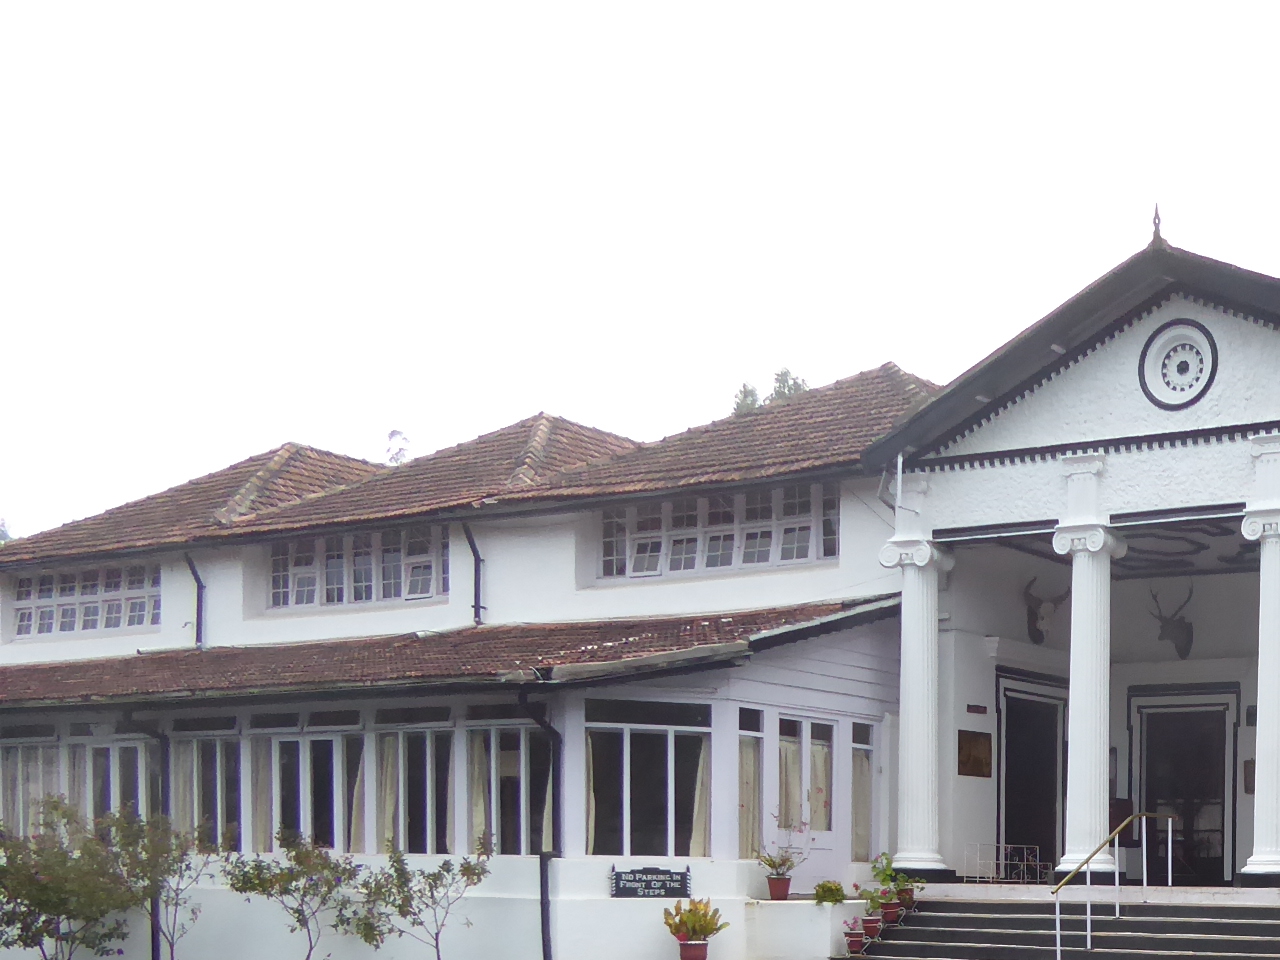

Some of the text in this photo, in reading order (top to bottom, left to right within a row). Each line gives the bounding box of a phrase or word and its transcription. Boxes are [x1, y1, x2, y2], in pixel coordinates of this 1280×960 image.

[621, 873, 681, 881] NO PARKING IN
[637, 888, 666, 896] STEPS
